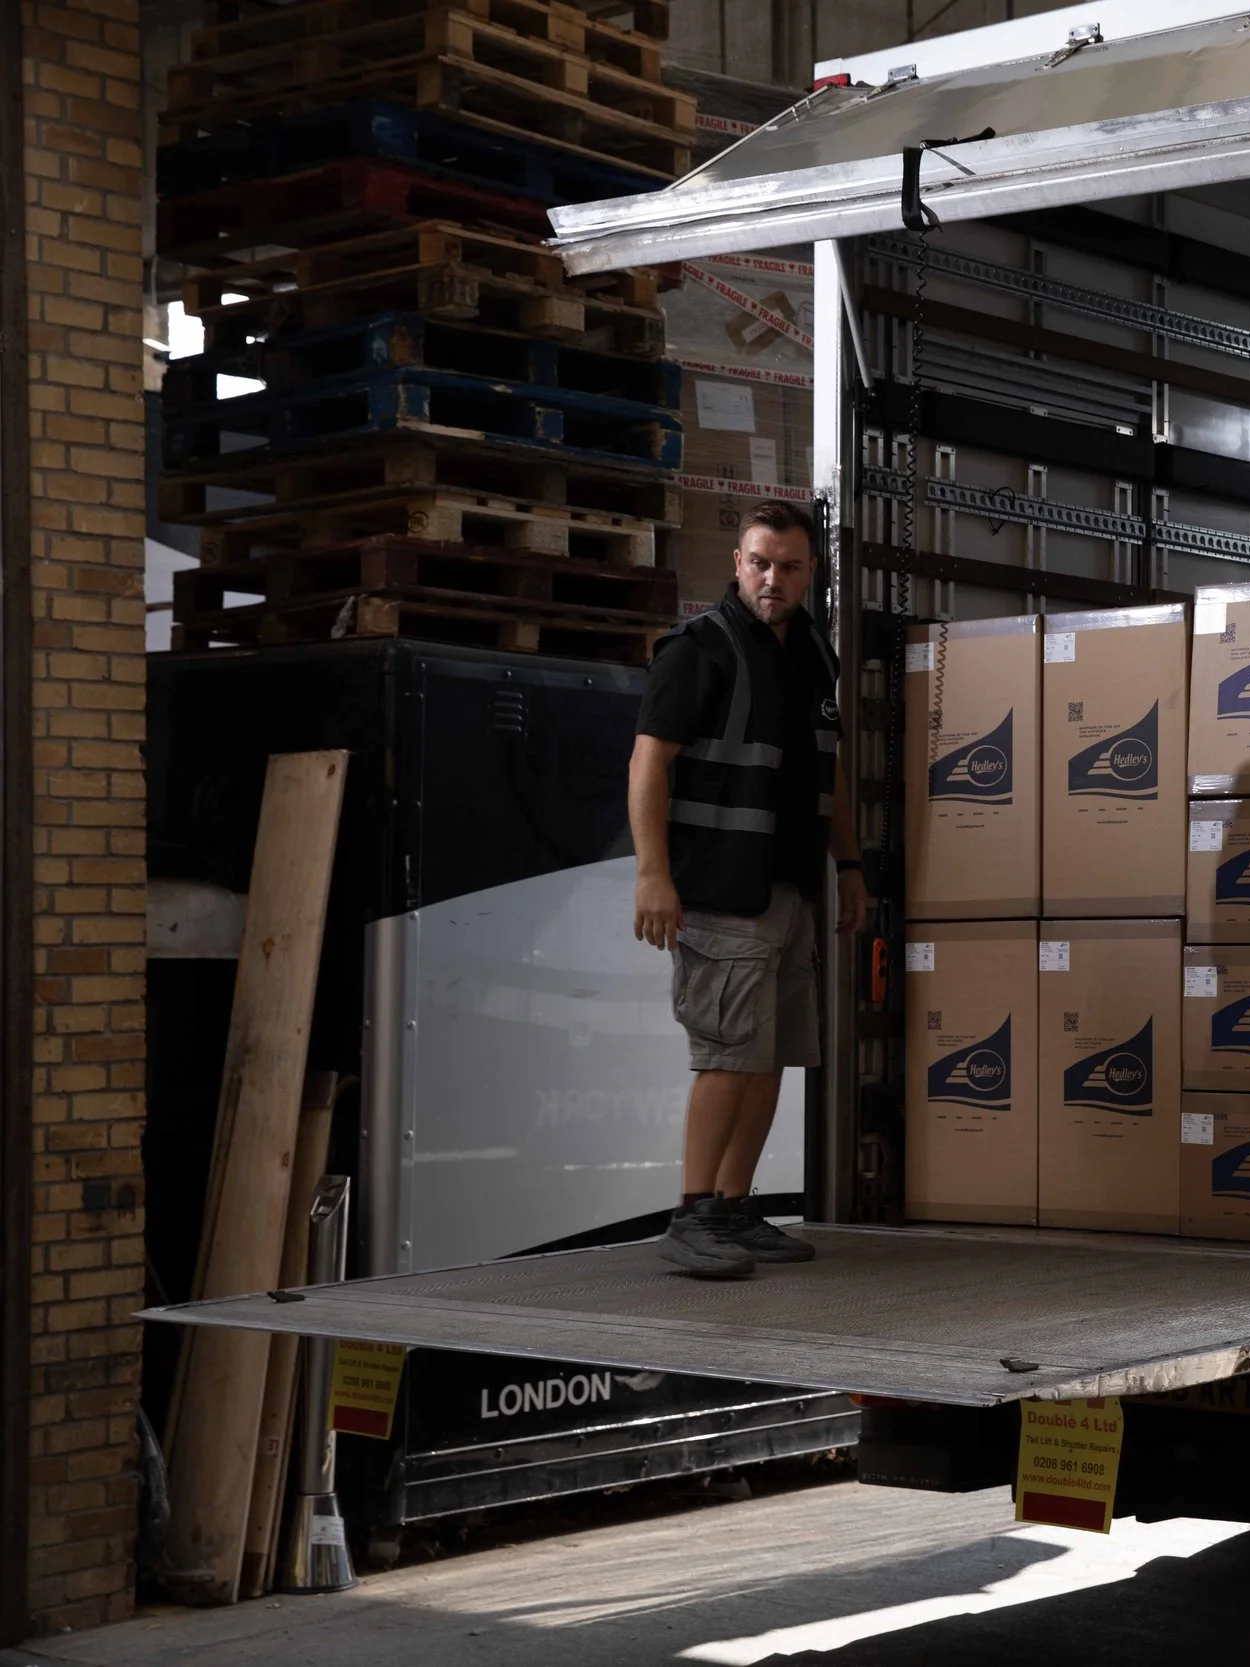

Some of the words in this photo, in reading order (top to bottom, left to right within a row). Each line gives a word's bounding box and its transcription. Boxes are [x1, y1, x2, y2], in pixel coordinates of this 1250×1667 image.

[753, 259, 786, 273] FRAGILE
[715, 281, 748, 307] FRAGILE
[758, 306, 790, 334] FRAGILE
[774, 372, 805, 387] FRAGILE
[728, 481, 761, 495] FRAGILE
[774, 487, 806, 500] FRAGILE
[971, 759, 1004, 776] Hedley's
[1114, 753, 1148, 769] Hedley's
[970, 1063, 1002, 1078] Hedley's
[1109, 1067, 1143, 1082] Hedley's
[481, 1371, 611, 1419] LONDON
[1027, 1410, 1076, 1429] Double
[1080, 1417, 1090, 1431] 4
[1094, 1418, 1117, 1434] Ltd
[1025, 1435, 1039, 1445] Tail
[1040, 1437, 1052, 1447] Lift
[1053, 1439, 1060, 1447] &
[1061, 1439, 1088, 1451] Shutter
[1089, 1443, 1117, 1454] Repairs
[1033, 1455, 1057, 1470] 0208
[1059, 1458, 1078, 1473] 961
[1081, 1462, 1105, 1476] 6908
[1022, 1472, 1112, 1493] www.double4ltd.com
